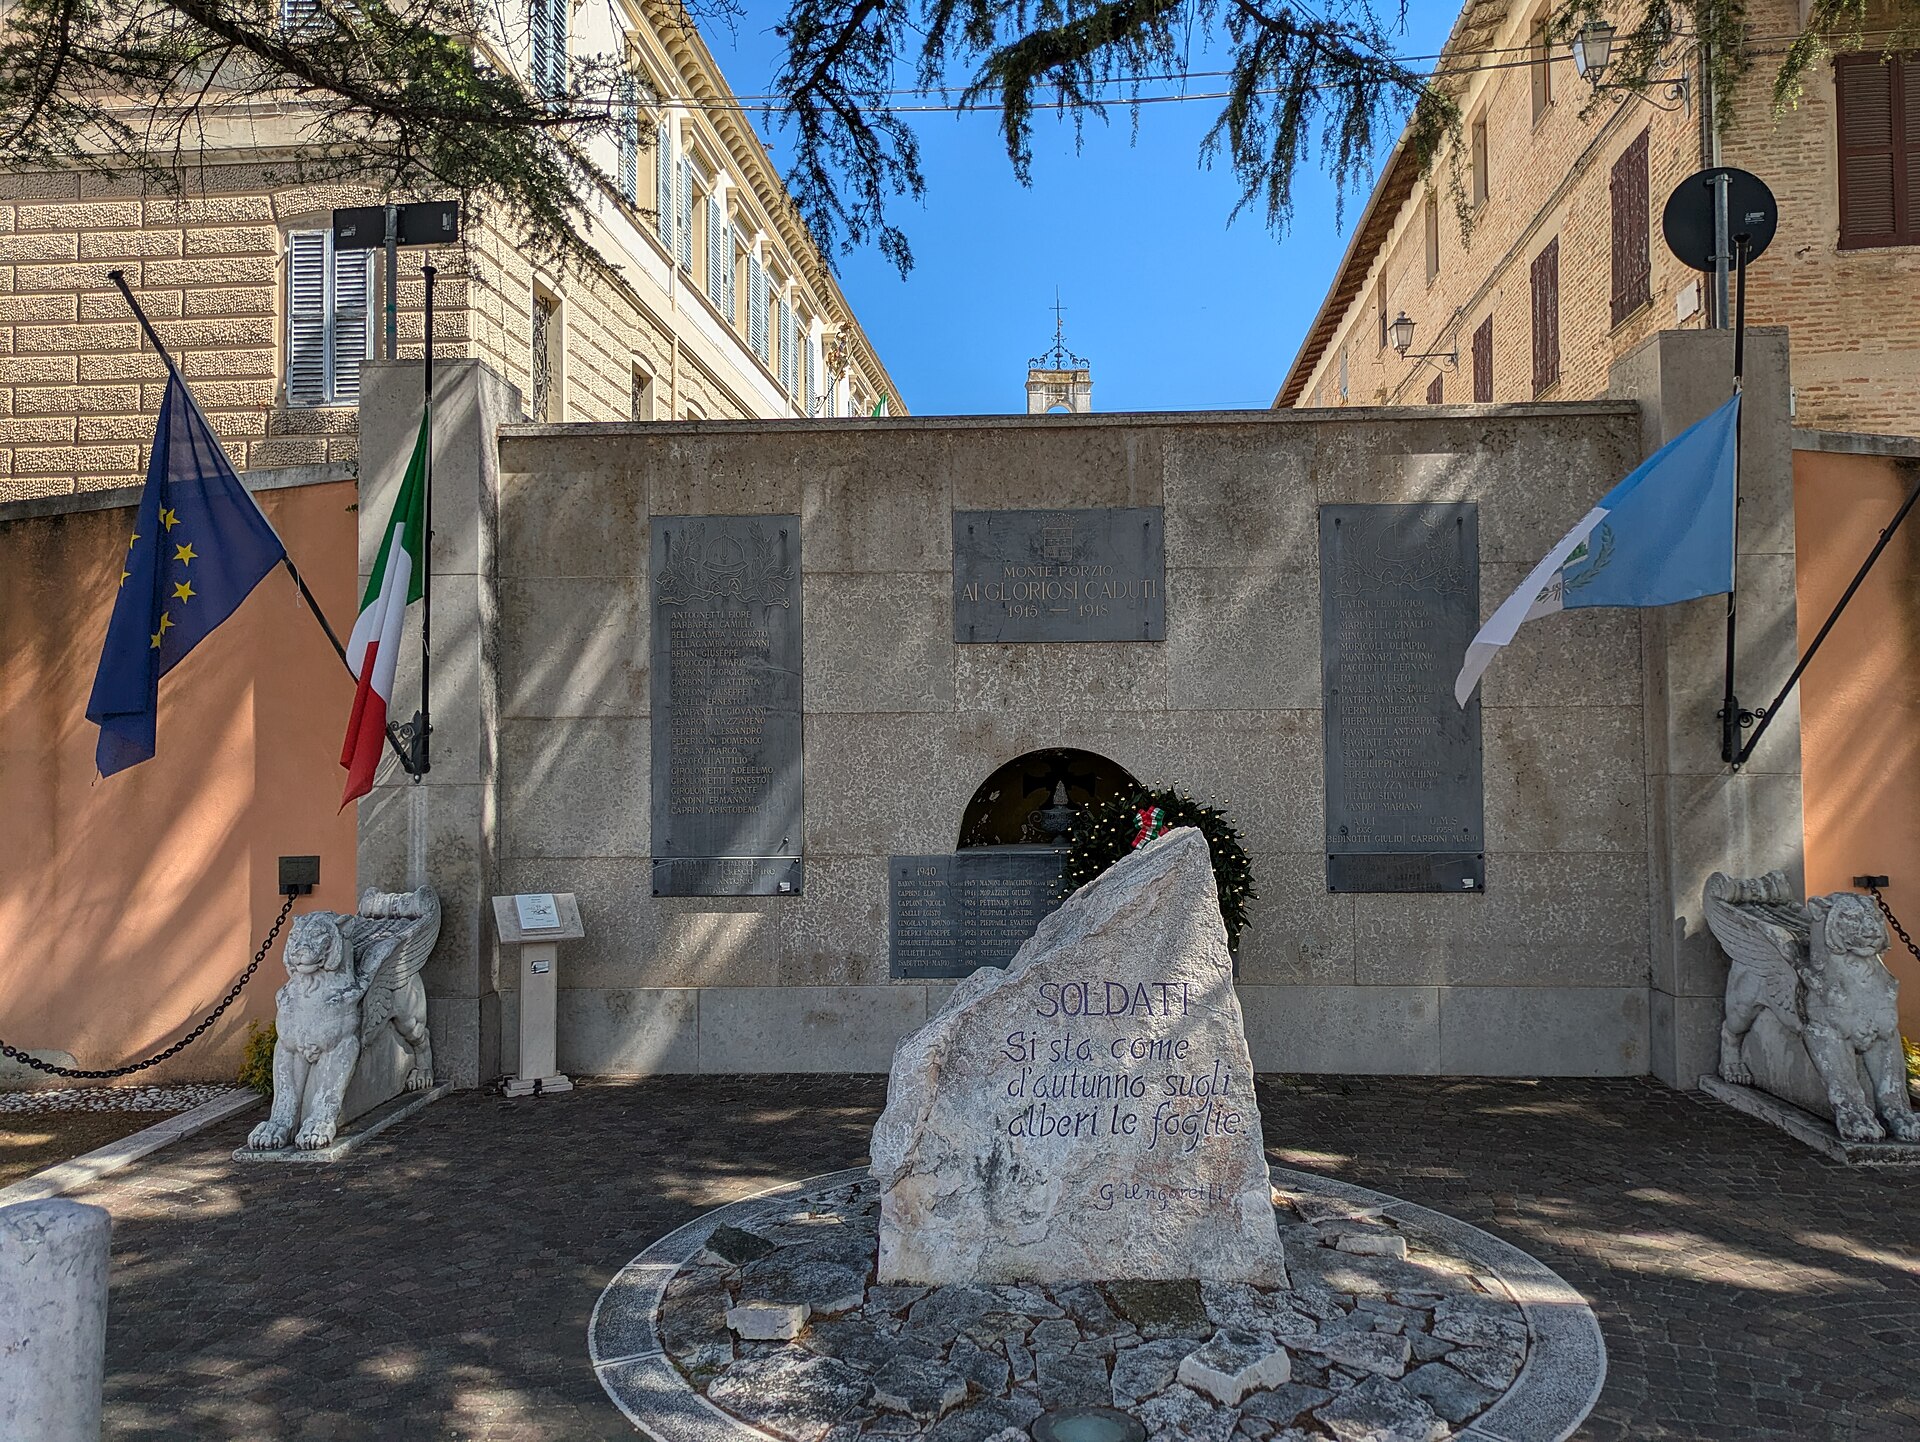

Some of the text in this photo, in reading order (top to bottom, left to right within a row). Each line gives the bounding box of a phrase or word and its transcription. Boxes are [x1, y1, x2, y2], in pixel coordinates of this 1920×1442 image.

[1004, 565, 1113, 578] MONTE PORZIO
[961, 580, 1157, 602] AI GLORIOSI CADUTI
[1339, 599, 1425, 609] LATINI TEODORICO
[671, 610, 751, 619] ANTOGNETTI FIORE
[1008, 604, 1109, 620] 1915 1918
[1340, 610, 1429, 619] MANCINI TOMMASO
[671, 621, 756, 629] BARBARESI CAMILLO
[1340, 620, 1433, 630] MARINELLI RINALDO
[671, 630, 768, 639] BELLAGAMBA AUGUSTO
[1340, 631, 1412, 640] MINUCCI MARIO
[671, 640, 770, 648] BELLAGAMBA GIOVANNI
[1340, 641, 1426, 651] MORICOLI OLIMPIO
[671, 649, 739, 658] BEDINI GIUSEPPE
[1340, 652, 1436, 662] MONTANARI ANTONIO
[671, 669, 706, 677] CARBONI
[671, 679, 706, 687] CARBONI
[720, 678, 760, 686] BATTISTA
[1340, 674, 1375, 683] PAOLINI
[709, 688, 748, 696] GIUSEPPE
[1340, 685, 1377, 694] PAOLINI
[707, 698, 743, 706] ERNESTO
[1341, 695, 1429, 704] PATRIGNANI SANTE
[726, 707, 767, 715] GIOVANNI
[1341, 705, 1419, 715] PERINI ROBERTO
[671, 717, 766, 726] CESARONI NAZZARENO
[1341, 716, 1438, 725] PIERPAOLI GIUSEPPE
[671, 727, 762, 736] FEDERICI ALESSANDRO
[1342, 727, 1431, 736] RAGNETTI ANTONIO
[671, 737, 763, 745] FEDERICONI DOMENICO
[1342, 748, 1414, 758] SANTINI SANTE
[671, 757, 748, 765] GAROFOLI ATTILIO
[1343, 759, 1392, 768] SERFILIPPI
[671, 766, 774, 775] GIROLOMETTI ADELELMO
[1384, 769, 1438, 779] GIOACCHINO
[671, 776, 767, 785] GIROLOMETTI ERNESTO
[671, 786, 758, 794] GIROLOMETTI SANTE
[1343, 791, 1407, 800] VITALI SILVIO
[671, 796, 751, 805] LANDINI ERMANNO
[708, 806, 760, 814] ARISTODEMO
[1382, 802, 1422, 811] MARIANO
[1327, 834, 1403, 843] BEDINOTTI GIULIO
[1410, 834, 1447, 843] CARBONI
[917, 866, 937, 877] 1940
[923, 929, 952, 937] GIUSEPPE
[897, 949, 926, 957] GIULIETTI
[1037, 981, 1189, 1017] SOLDATI
[1000, 1030, 1189, 1063] Si sta come
[1007, 1059, 1232, 1114] d'autunno sugli
[1008, 1101, 1248, 1153] alberi le foglie.
[1120, 1182, 1223, 1212] Ungaretti
